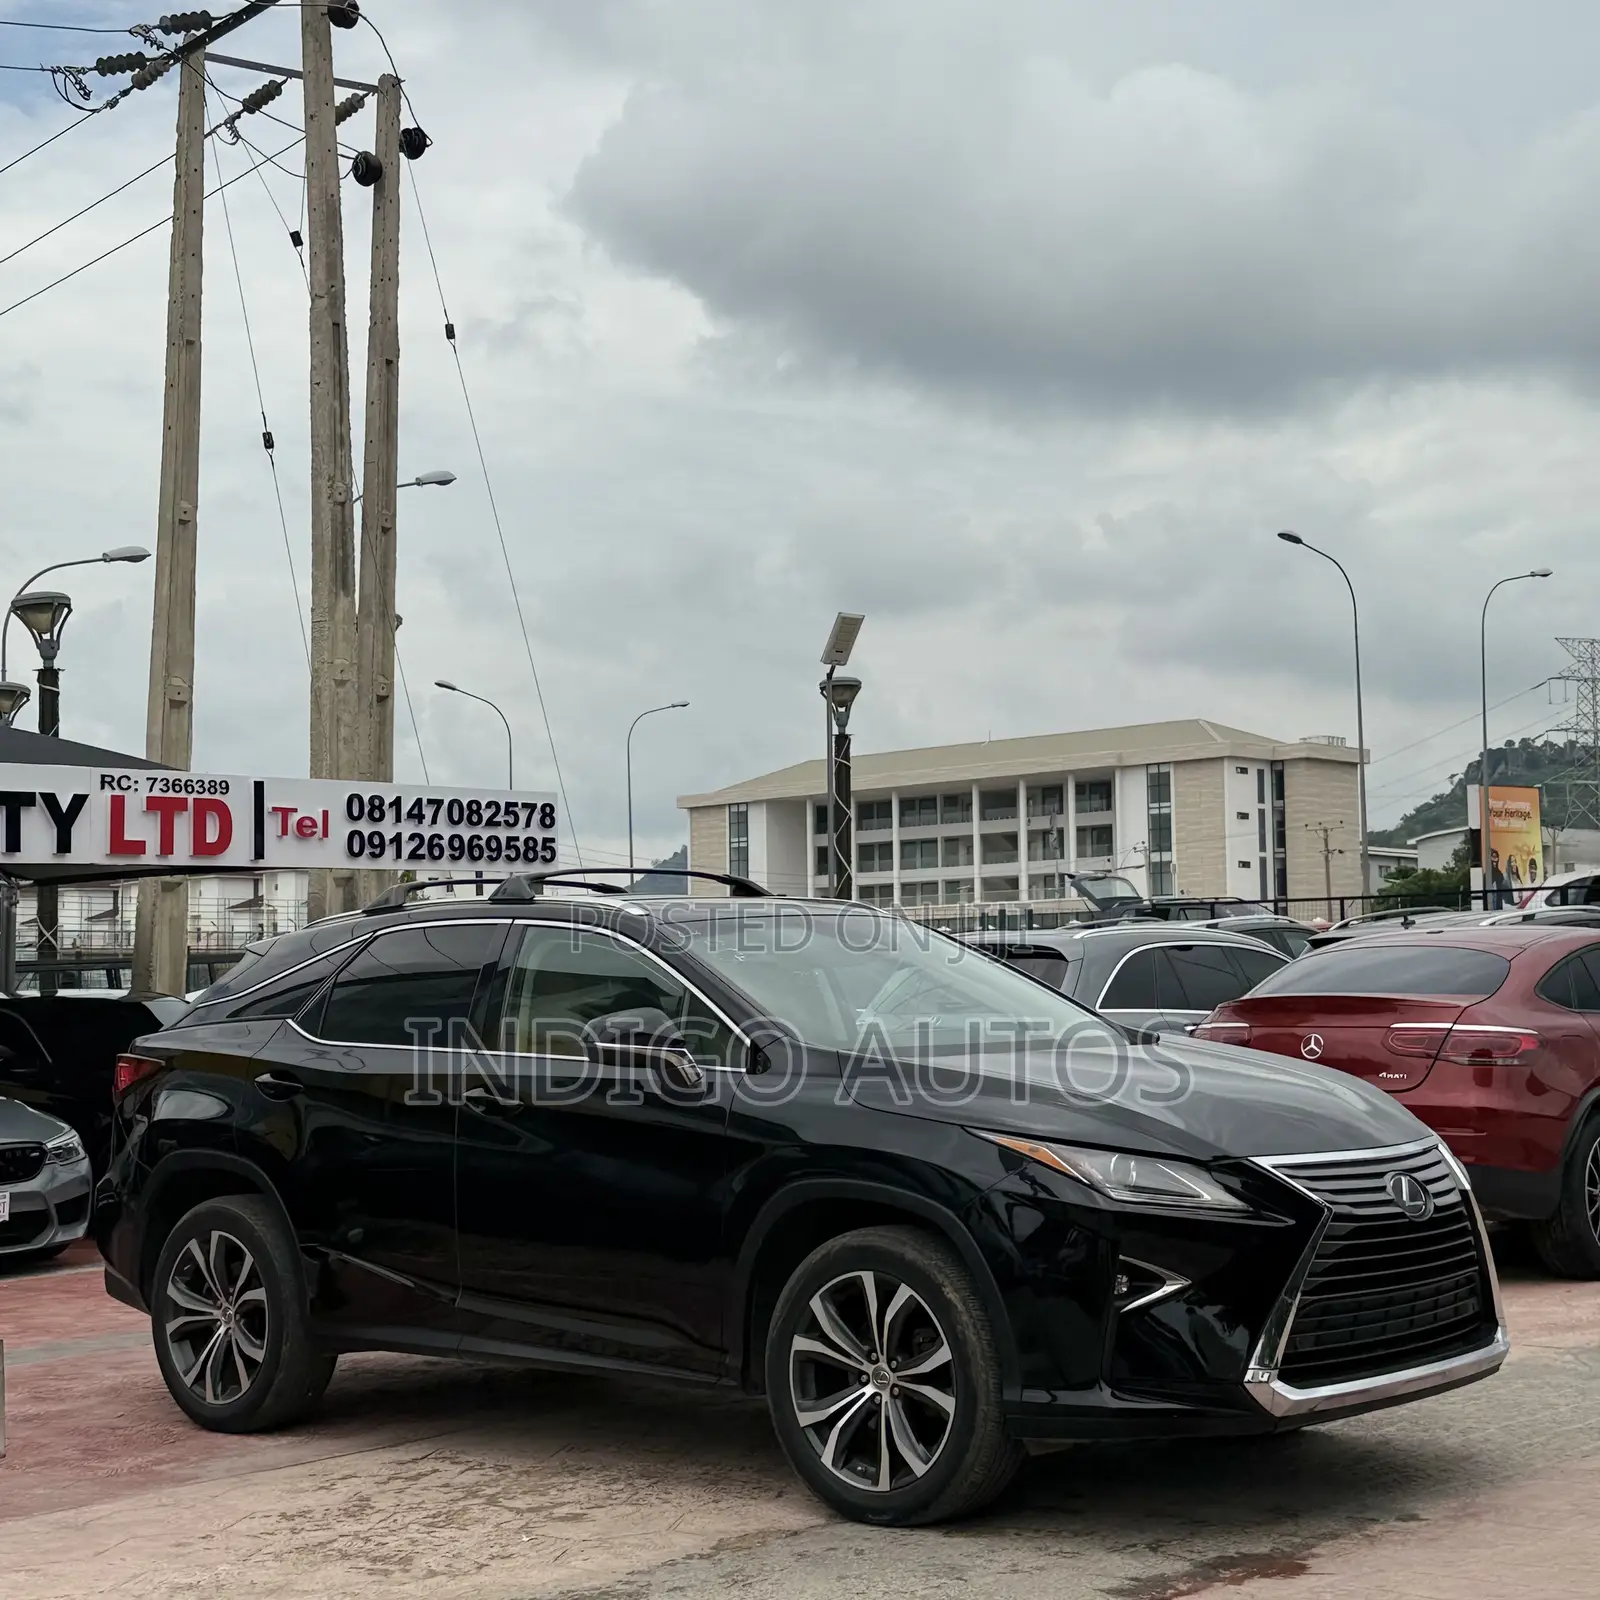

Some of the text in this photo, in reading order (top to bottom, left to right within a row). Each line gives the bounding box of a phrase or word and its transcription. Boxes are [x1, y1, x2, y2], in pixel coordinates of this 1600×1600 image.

[100, 774, 230, 795] RC: 7366389
[109, 794, 233, 856] LTD
[270, 806, 329, 839] Tel
[346, 793, 556, 830] 08147082578
[346, 829, 557, 863] 09126969585
